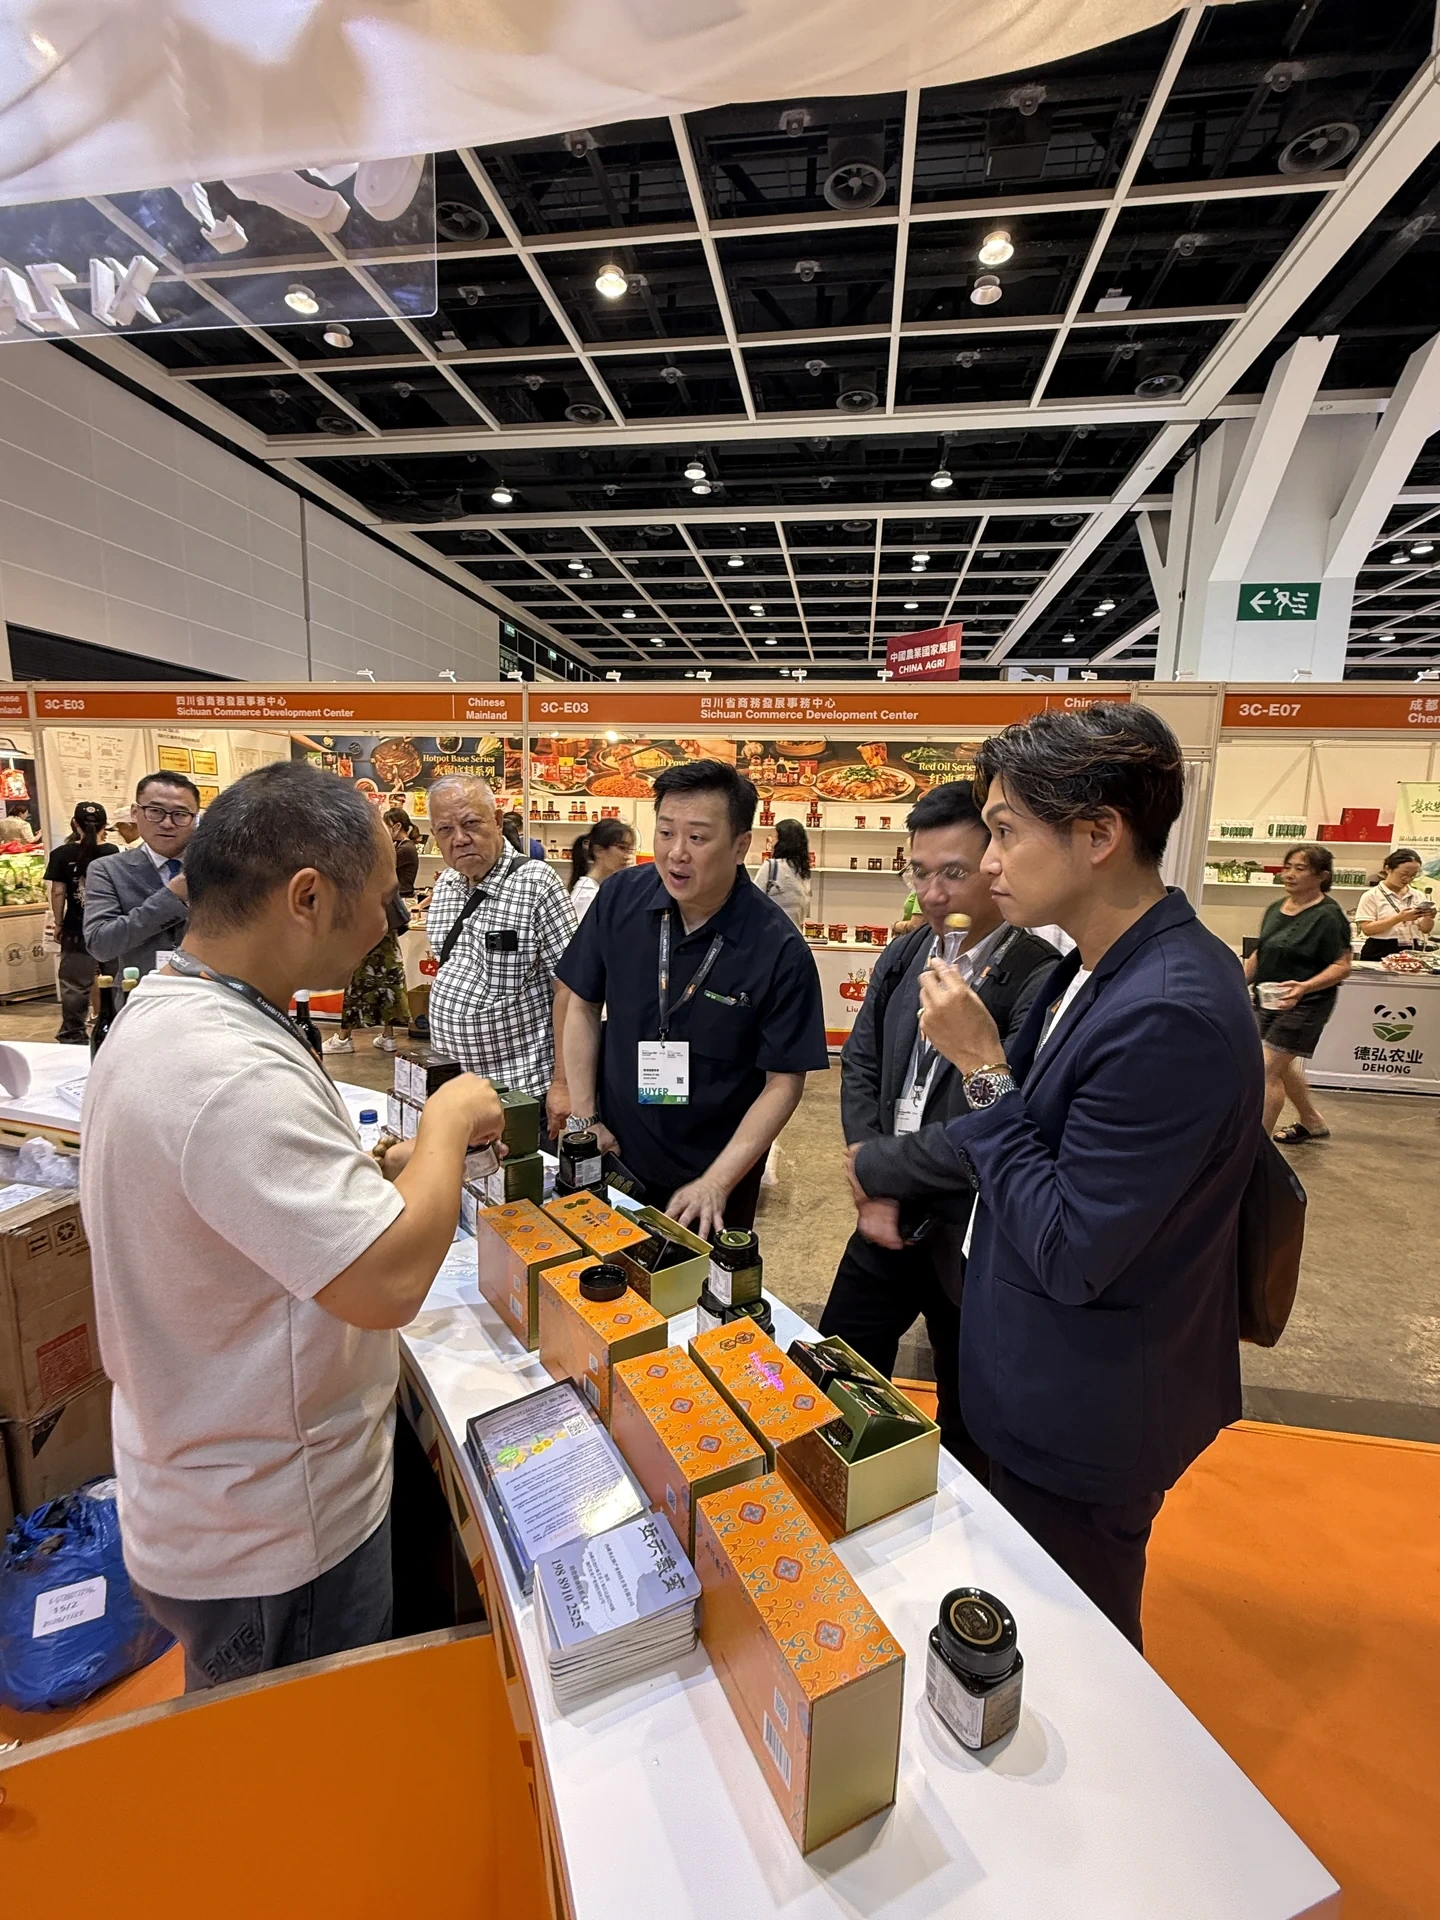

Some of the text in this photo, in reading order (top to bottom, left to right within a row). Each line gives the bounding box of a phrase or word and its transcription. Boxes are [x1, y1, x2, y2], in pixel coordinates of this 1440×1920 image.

[889, 639, 957, 663] 中國農業國家展團
[898, 658, 946, 675] CHINA AGRI
[44, 699, 85, 710] 3C-E03
[176, 696, 287, 706] 四川省商務發展事務中心
[468, 697, 505, 707] Chinese
[700, 697, 836, 709] 四川省商務發展事務中心
[1409, 698, 1439, 711] 成都
[176, 707, 355, 718] Sichuan Commerce Development Center
[540, 702, 589, 713] 3C-E03
[1239, 703, 1301, 716] 3C-E07
[466, 710, 507, 720] Mainland
[700, 709, 919, 721] Sichuan Commerce Development Center
[423, 754, 496, 764] Hotpot Base Series
[918, 762, 977, 772] Red Oil Serie
[846, 1005, 859, 1013] Liu
[1353, 1045, 1424, 1064] 德弘农业
[1362, 1062, 1411, 1075] DEHONG
[639, 1087, 669, 1096] BUYER
[550, 1557, 585, 1630] 198 8910 2525
